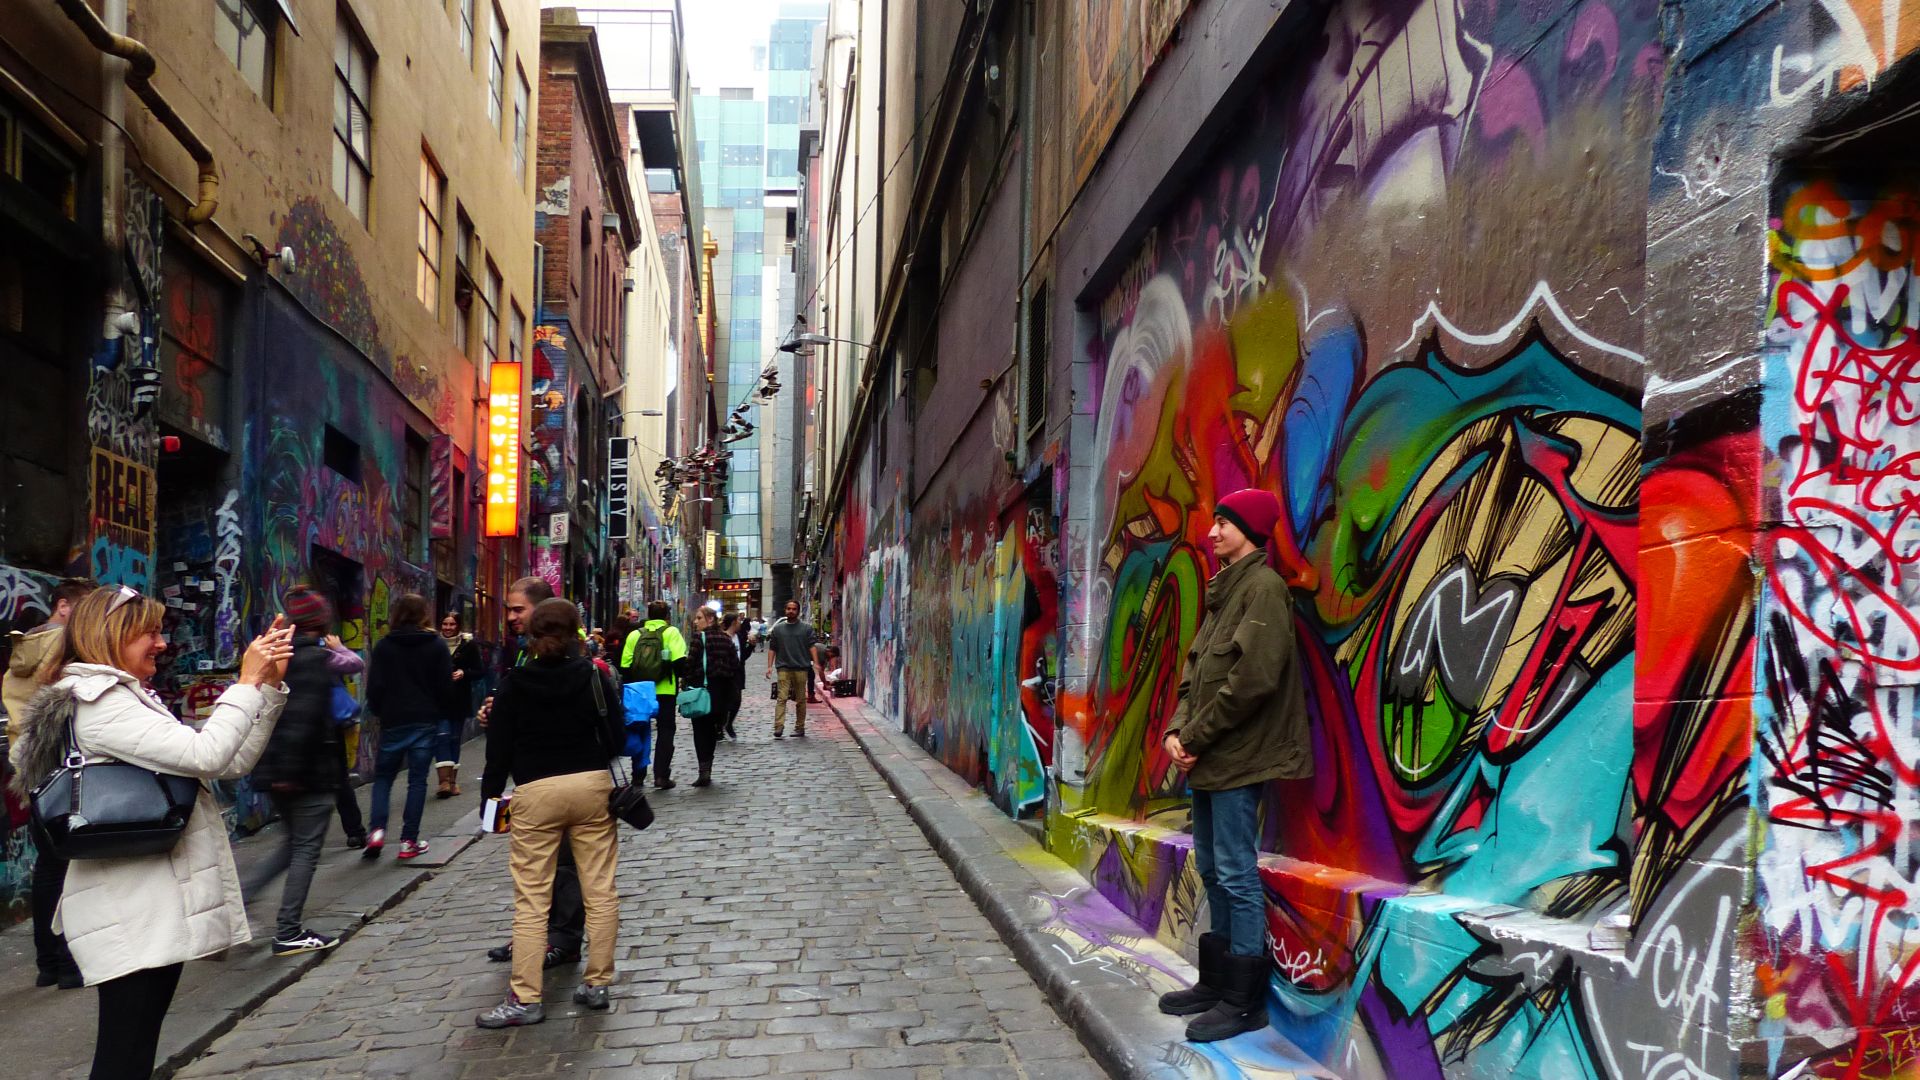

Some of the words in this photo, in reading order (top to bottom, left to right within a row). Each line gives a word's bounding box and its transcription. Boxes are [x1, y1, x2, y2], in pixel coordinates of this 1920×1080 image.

[490, 393, 509, 504] MOVIDA
[610, 457, 627, 517] MISTY
[96, 454, 150, 532] REAL
